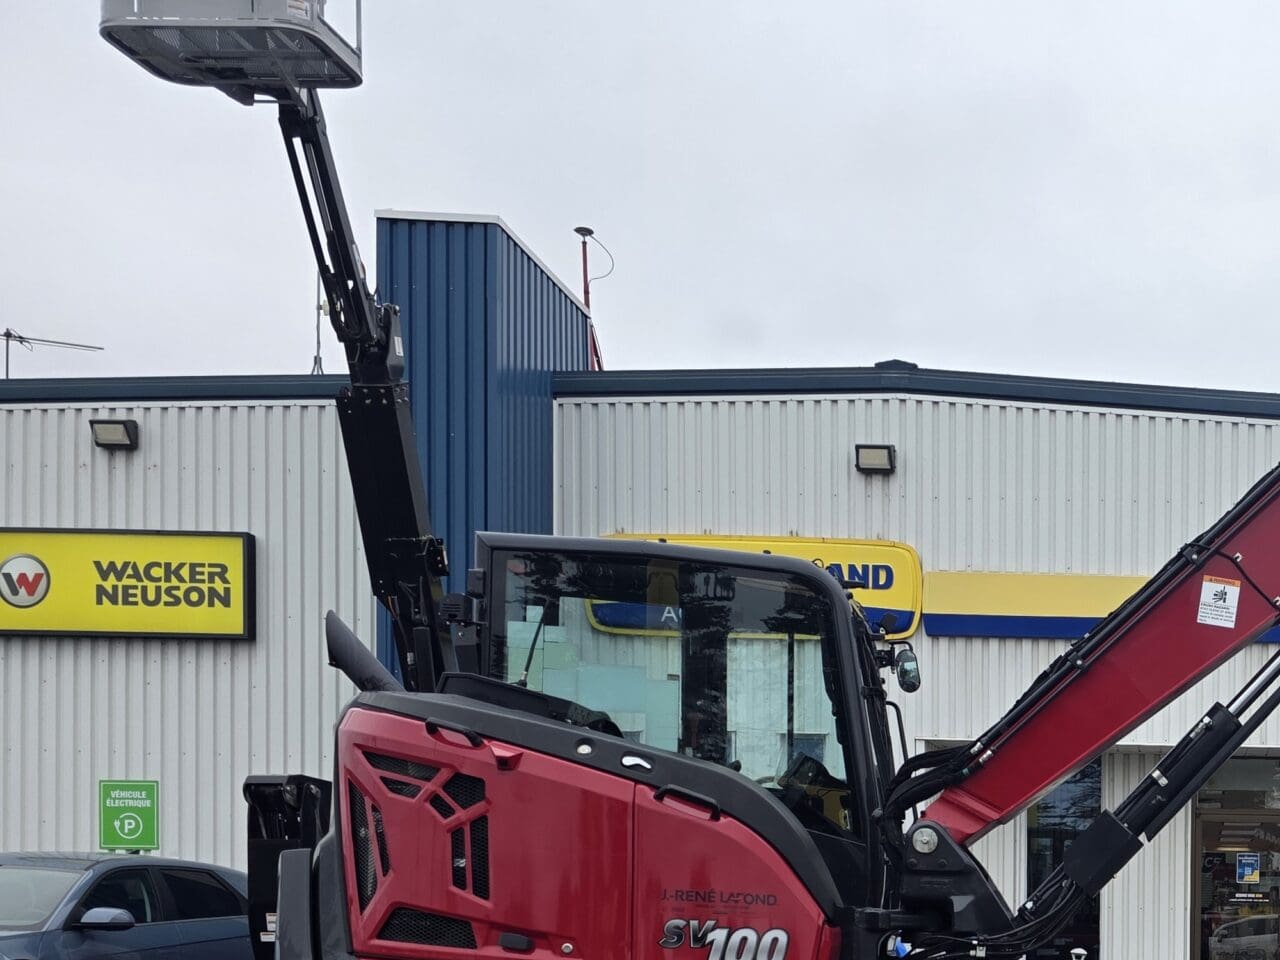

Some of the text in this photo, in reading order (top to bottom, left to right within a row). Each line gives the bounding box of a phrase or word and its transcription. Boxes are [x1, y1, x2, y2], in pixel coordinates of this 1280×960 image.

[93, 560, 231, 584] WACKER
[95, 584, 231, 608] NEUSON
[110, 789, 147, 798] VÉHICULE
[106, 798, 152, 807] ÉLECTRIQUE
